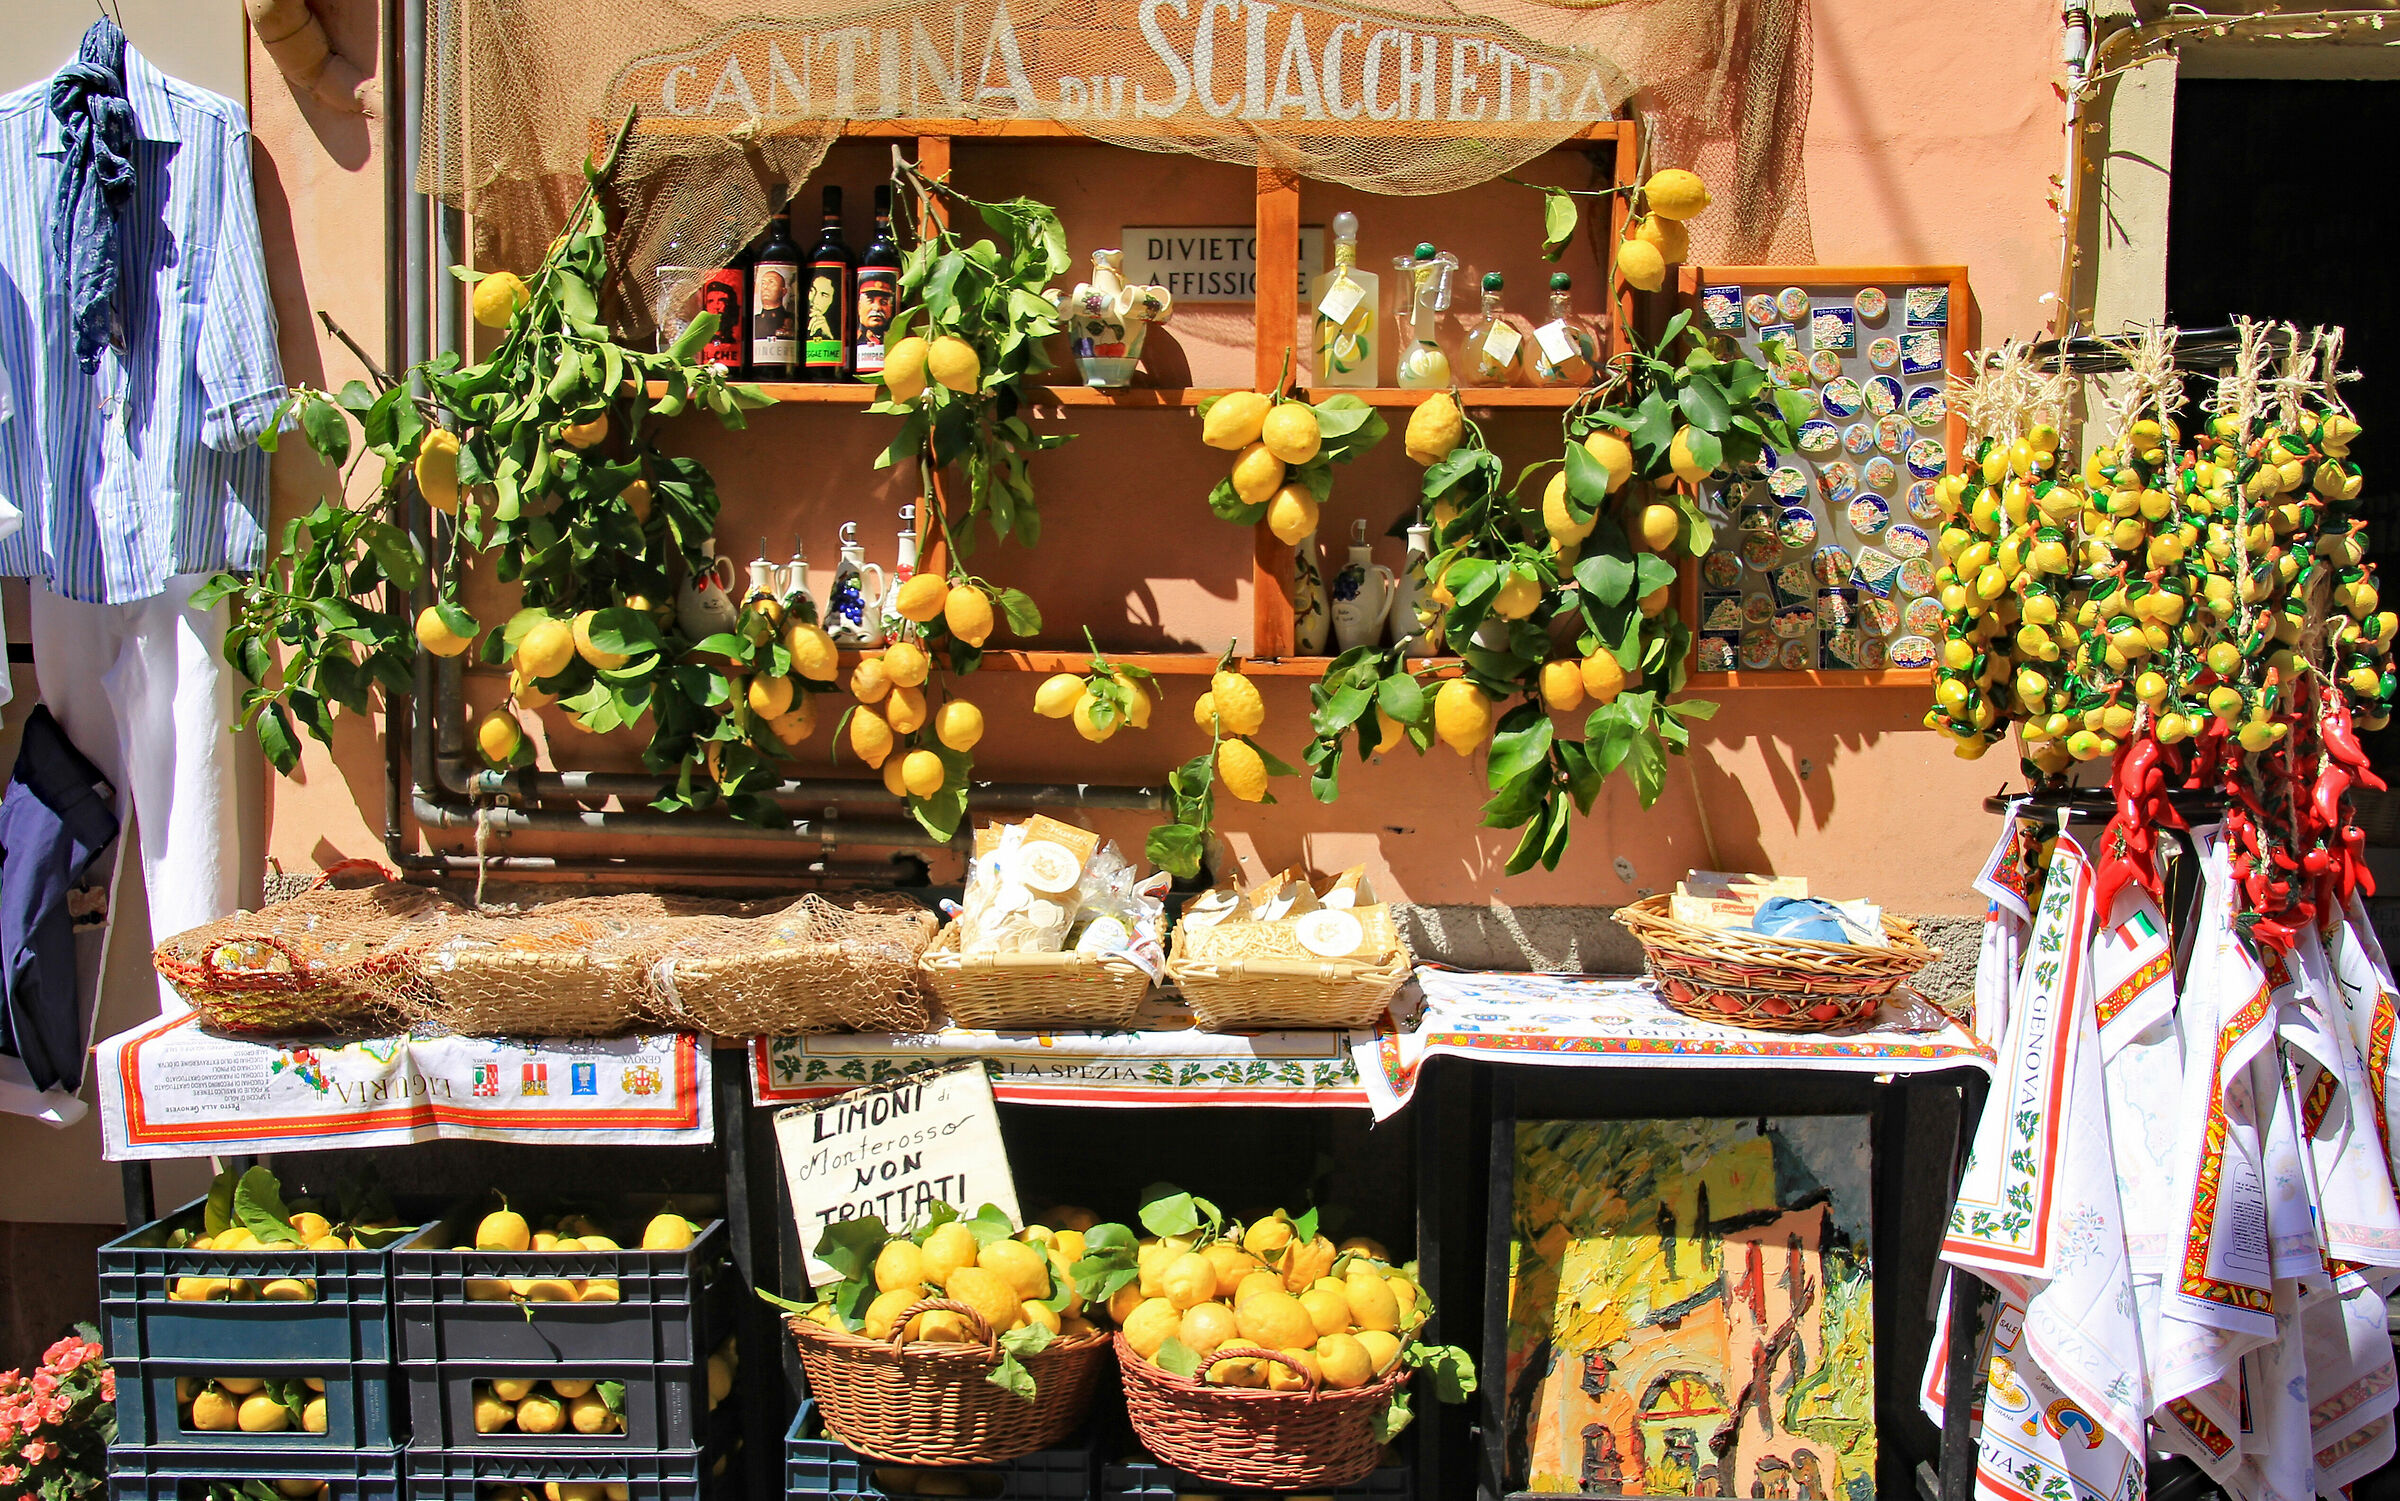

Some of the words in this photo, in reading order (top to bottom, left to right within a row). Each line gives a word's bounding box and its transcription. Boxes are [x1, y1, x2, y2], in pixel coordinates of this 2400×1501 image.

[661, 3, 1040, 119] CANTINA
[1149, 272, 1307, 295] AFFISSIE
[714, 351, 738, 361] CHE
[621, 1055, 662, 1064] GENOVA
[2021, 994, 2048, 1109] GENOVA
[1010, 1062, 1043, 1078] LA
[1051, 1064, 1138, 1081] SPEZIA
[336, 1076, 453, 1104] LIGURIA
[813, 1085, 923, 1143] LIMONI
[938, 1086, 951, 1102] di
[799, 1115, 976, 1181] Monterosso
[851, 1150, 923, 1194] NON
[816, 1173, 966, 1227] TRATTATI
[1999, 1319, 2019, 1335] SALE
[2040, 1382, 2059, 1395] PINOLI
[1992, 1407, 2014, 1422] GRANA
